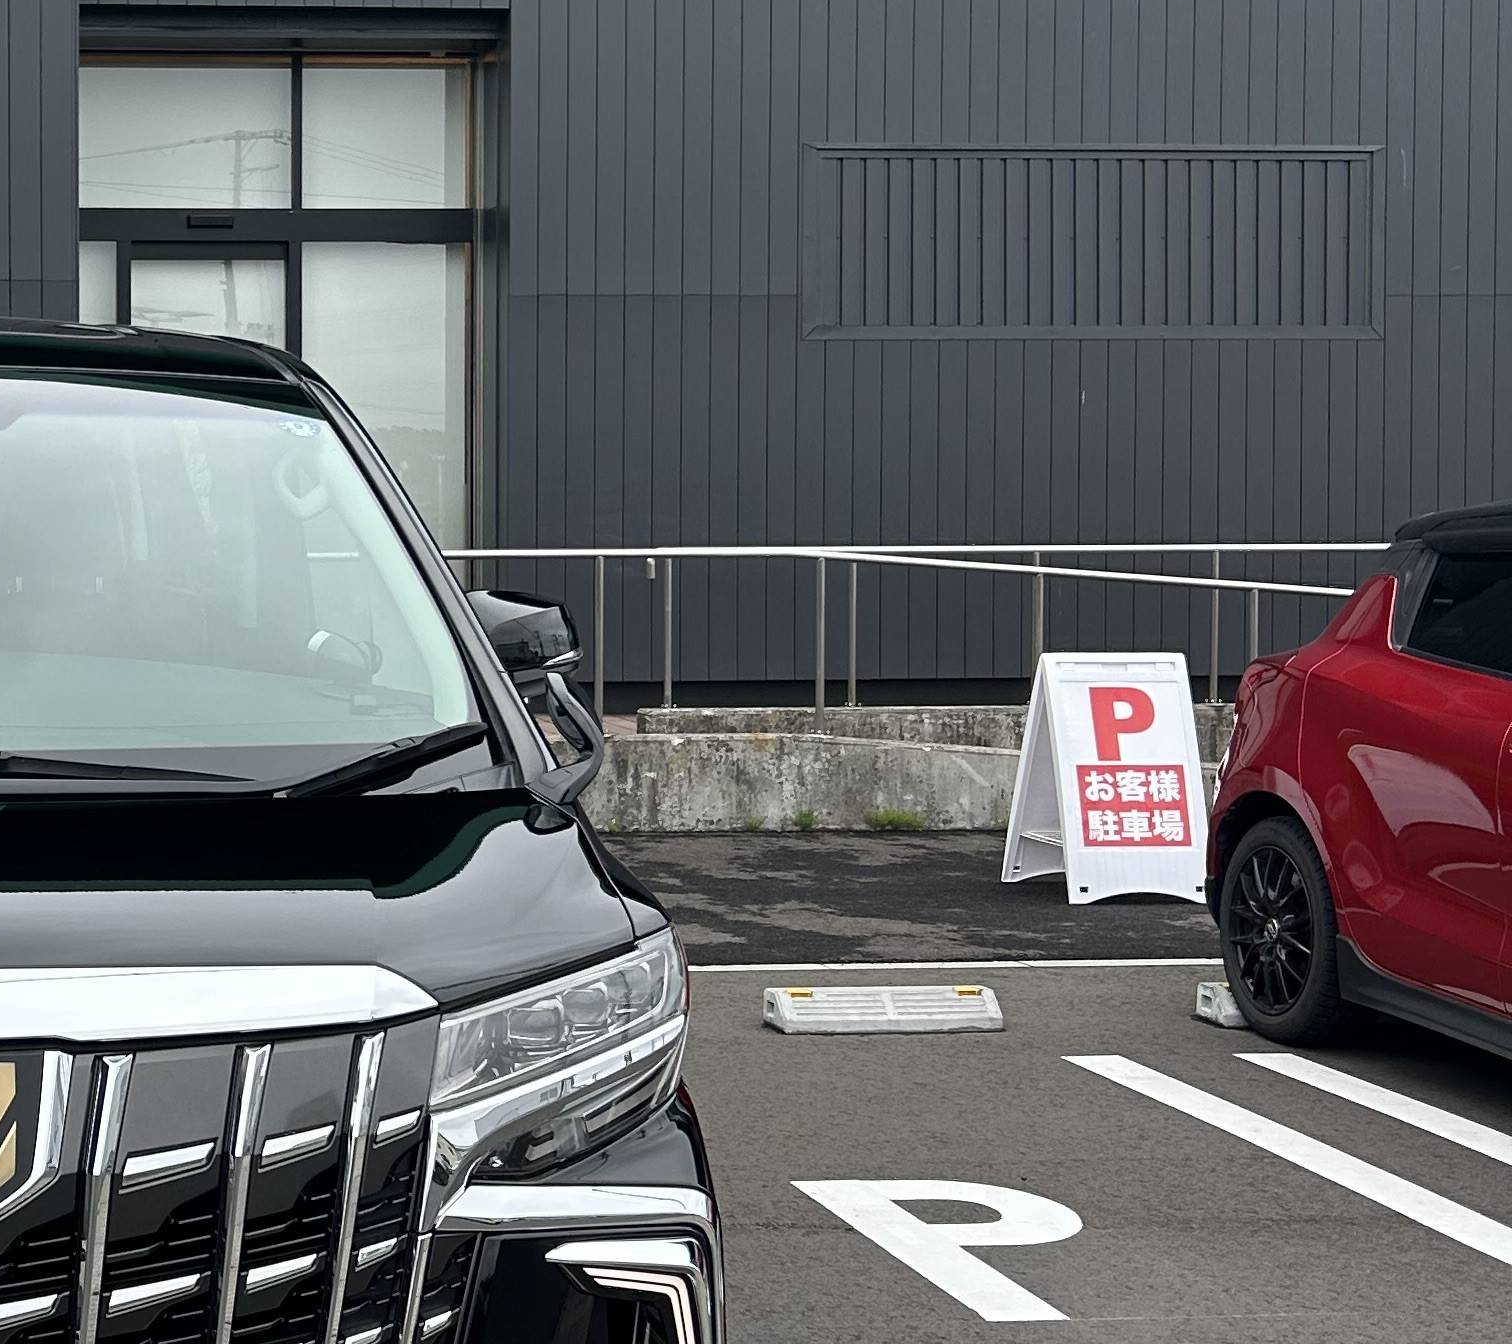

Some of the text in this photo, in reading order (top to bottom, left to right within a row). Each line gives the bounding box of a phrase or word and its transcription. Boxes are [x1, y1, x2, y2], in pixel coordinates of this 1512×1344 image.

[1088, 686, 1156, 762] P
[1084, 769, 1181, 803] お客様
[1087, 809, 1185, 843] 駐車場
[790, 1178, 1084, 1322] P
